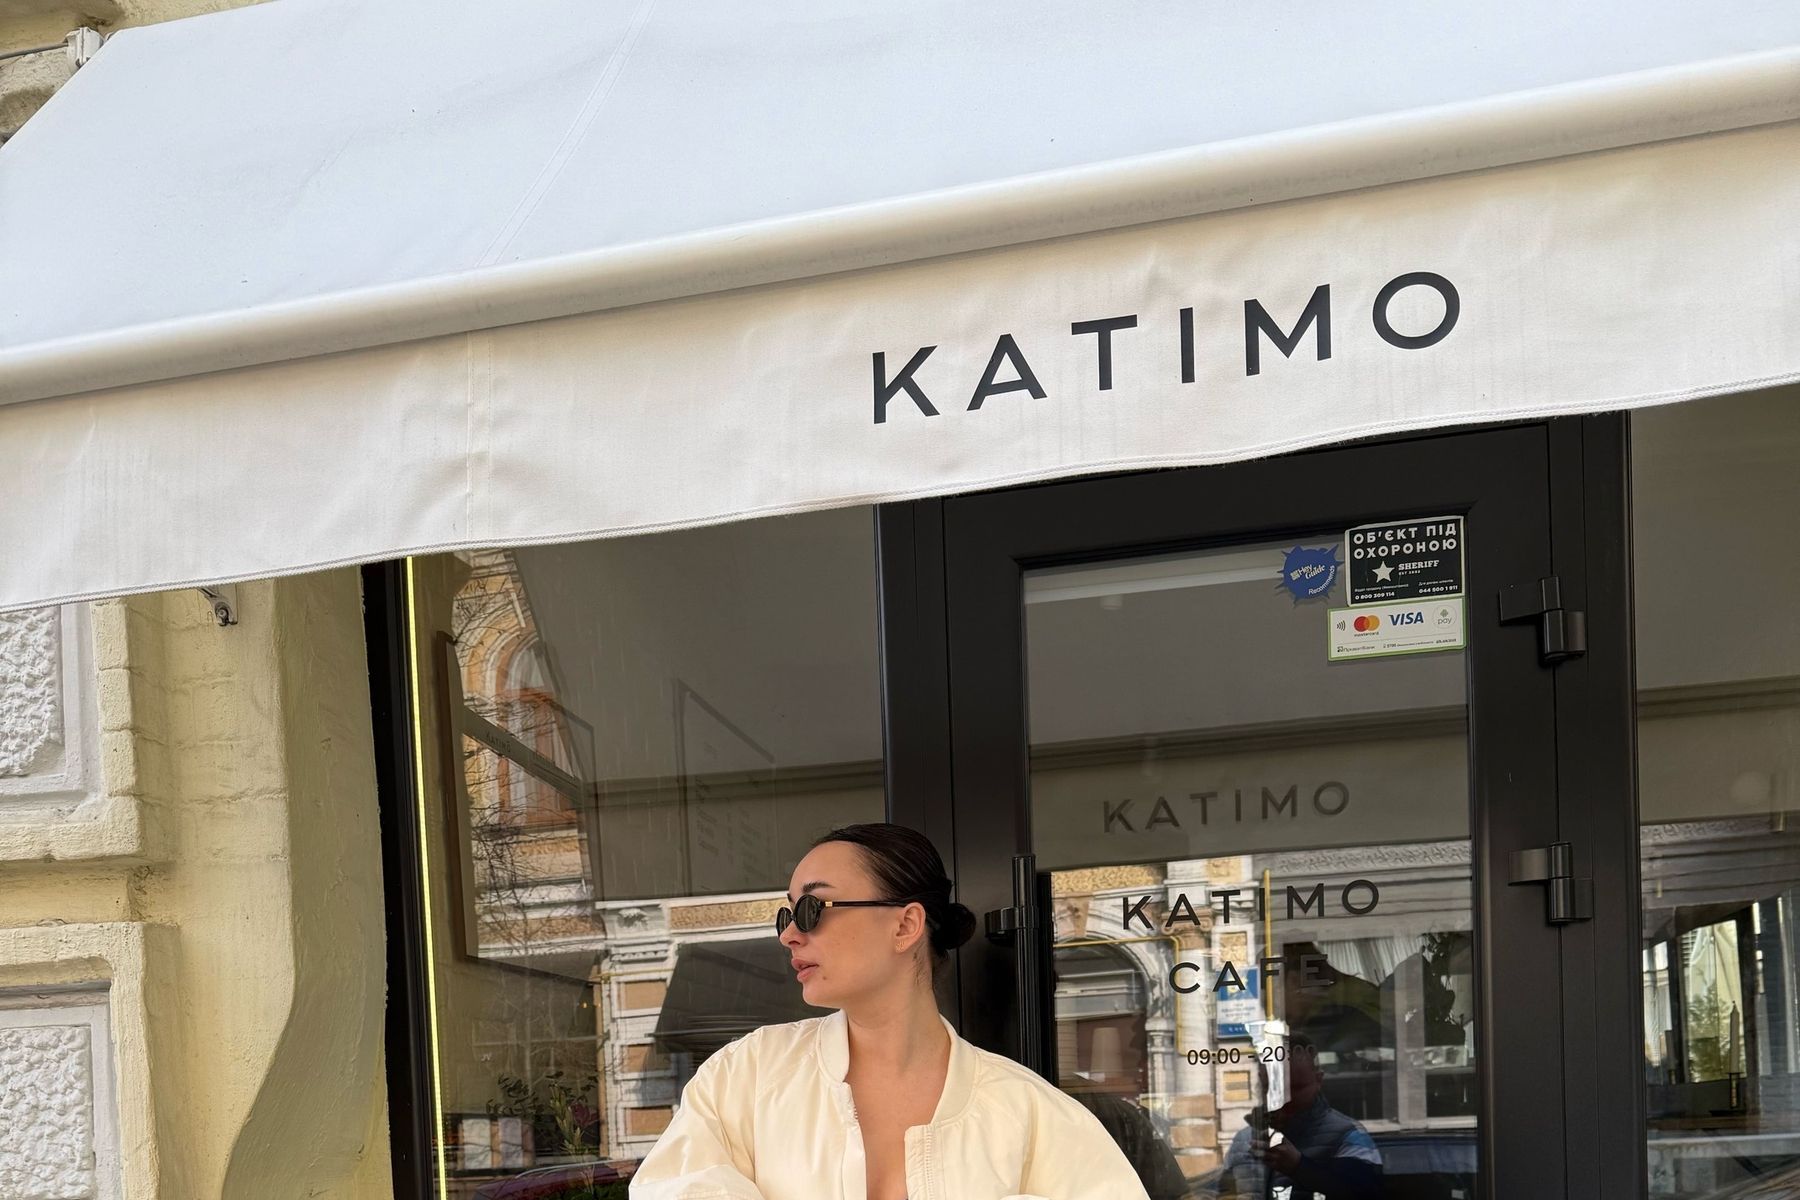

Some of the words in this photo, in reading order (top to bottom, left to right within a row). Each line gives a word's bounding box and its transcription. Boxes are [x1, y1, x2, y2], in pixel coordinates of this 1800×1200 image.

[872, 271, 1461, 425] KATIMO
[1353, 527, 1418, 545] ОБ'ЄКТ
[1426, 523, 1457, 537] ПІД
[1353, 538, 1457, 559] ОХОРОНОЮ
[1398, 560, 1440, 571] SHERIFF
[1308, 565, 1335, 595] Recommends
[1389, 611, 1424, 626] VISA
[1103, 781, 1350, 833] KATIMO
[1122, 879, 1380, 930] KATIMO
[1168, 953, 1332, 994] CAFE
[1187, 1048, 1241, 1066] 09:00
